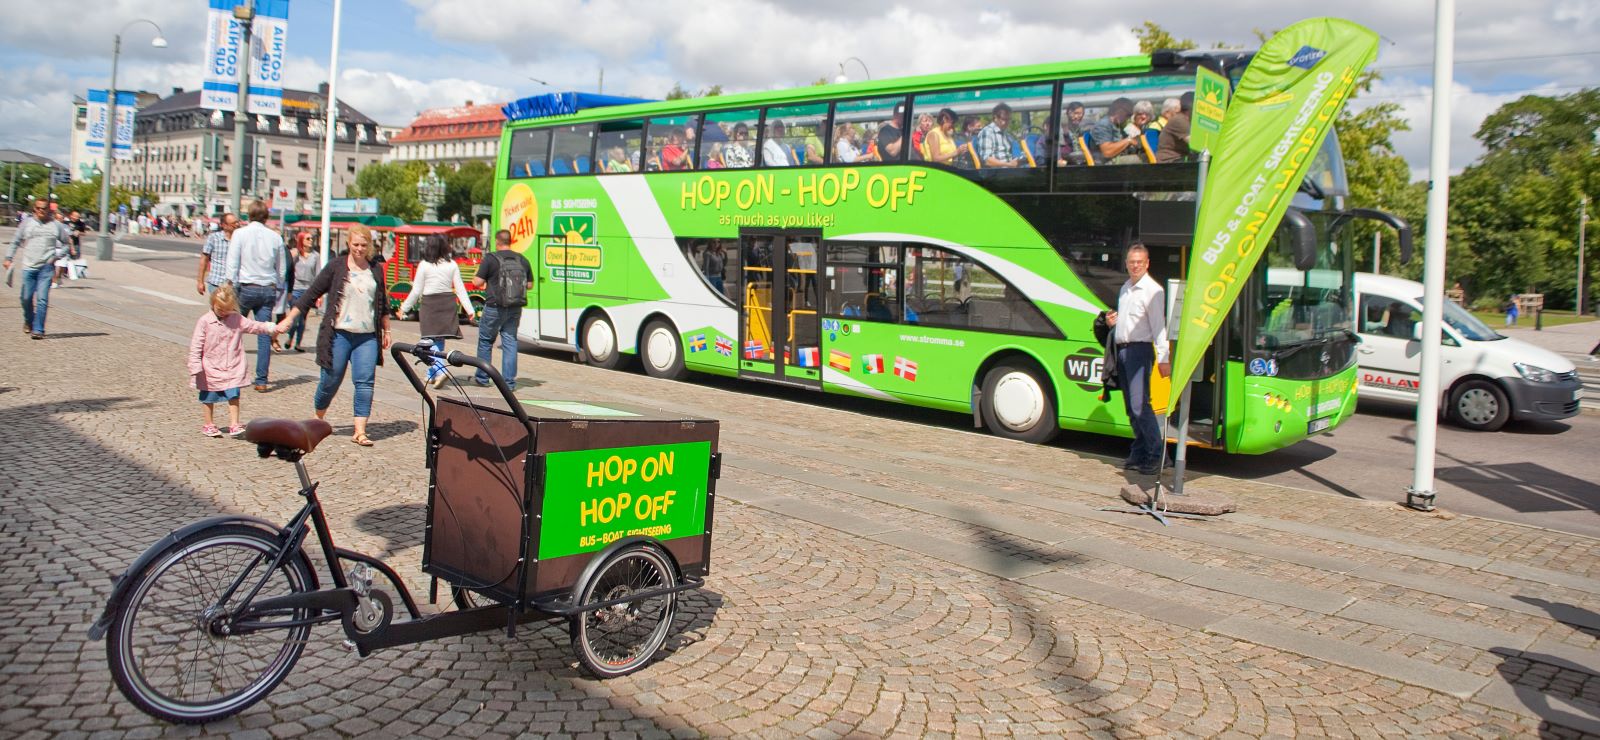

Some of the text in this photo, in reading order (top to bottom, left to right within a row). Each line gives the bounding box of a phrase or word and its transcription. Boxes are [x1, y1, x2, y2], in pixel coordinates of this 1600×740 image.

[1201, 230, 1231, 265] BUS
[1227, 217, 1240, 231] &
[1235, 174, 1268, 217] BOAT
[1265, 71, 1335, 170] SIGHTSEEING
[681, 175, 731, 210] HOP
[735, 173, 775, 210] ON
[798, 168, 860, 206] HOP
[865, 170, 928, 212] OFF
[509, 215, 534, 244] 24h
[719, 212, 835, 229] as much as you like!
[1191, 262, 1238, 329] HOP
[1237, 210, 1269, 258] ON
[899, 333, 965, 347] www.stromma.se
[586, 451, 675, 488] HOP ON
[580, 490, 676, 527] HOP OFF
